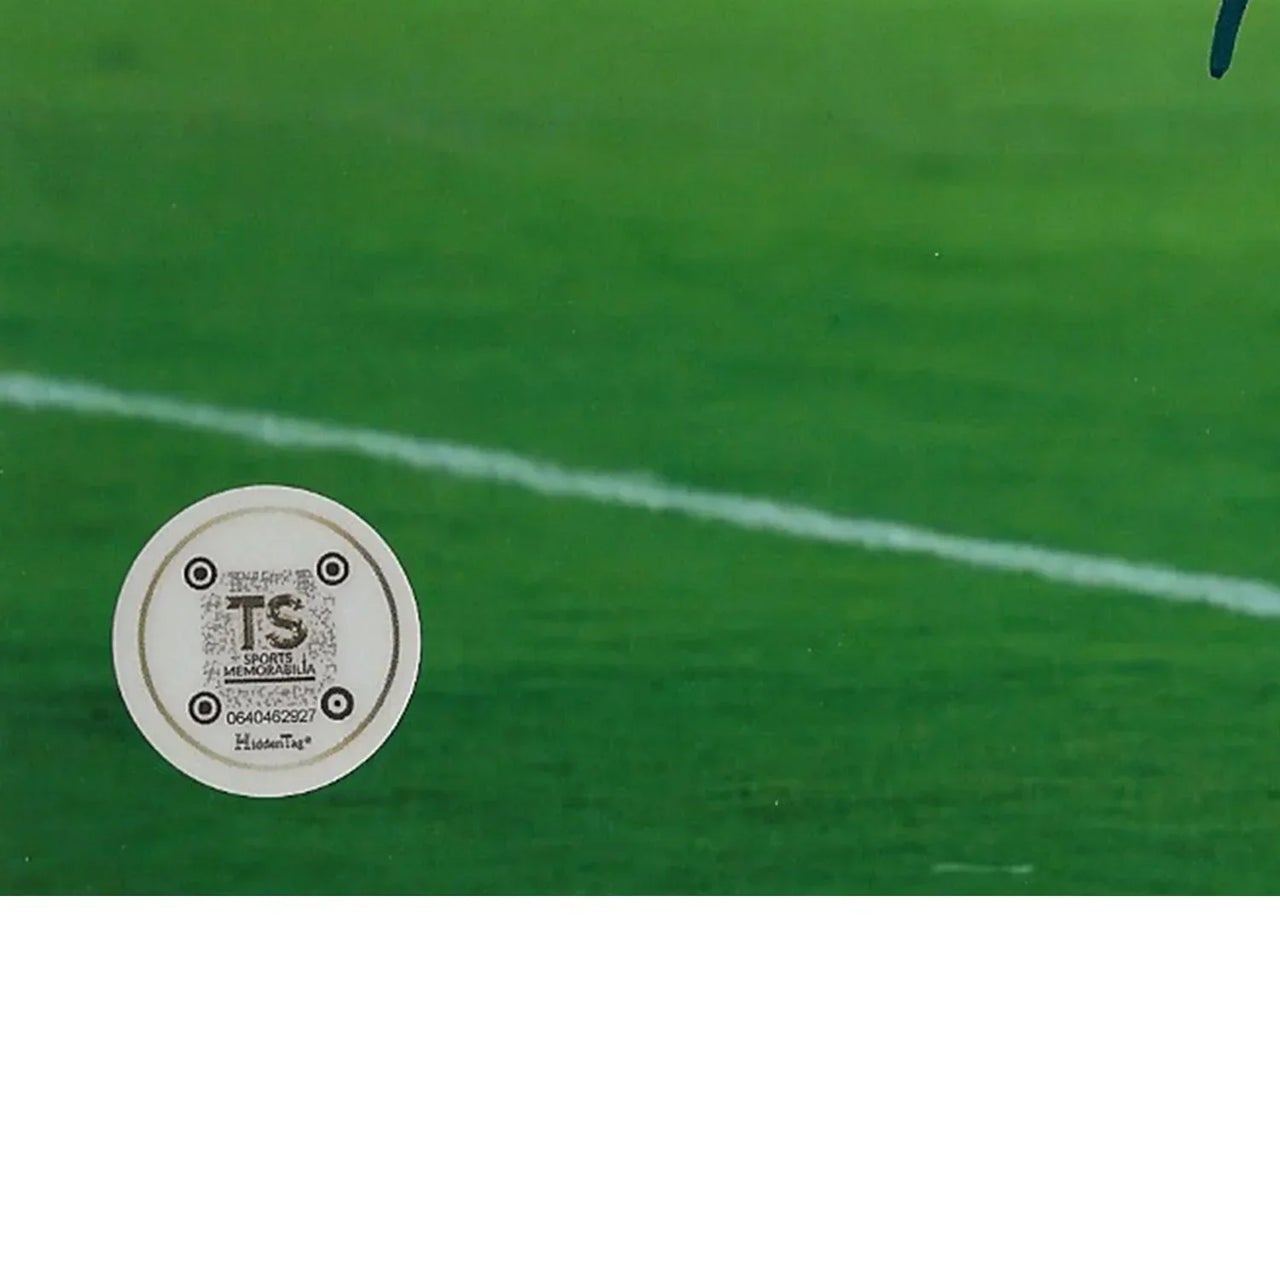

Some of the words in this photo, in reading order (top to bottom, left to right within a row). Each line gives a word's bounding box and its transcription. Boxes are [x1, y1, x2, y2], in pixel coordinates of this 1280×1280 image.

[225, 593, 308, 651] TS
[223, 657, 316, 676] MEMORABILIA
[243, 652, 293, 665] SPORTS
